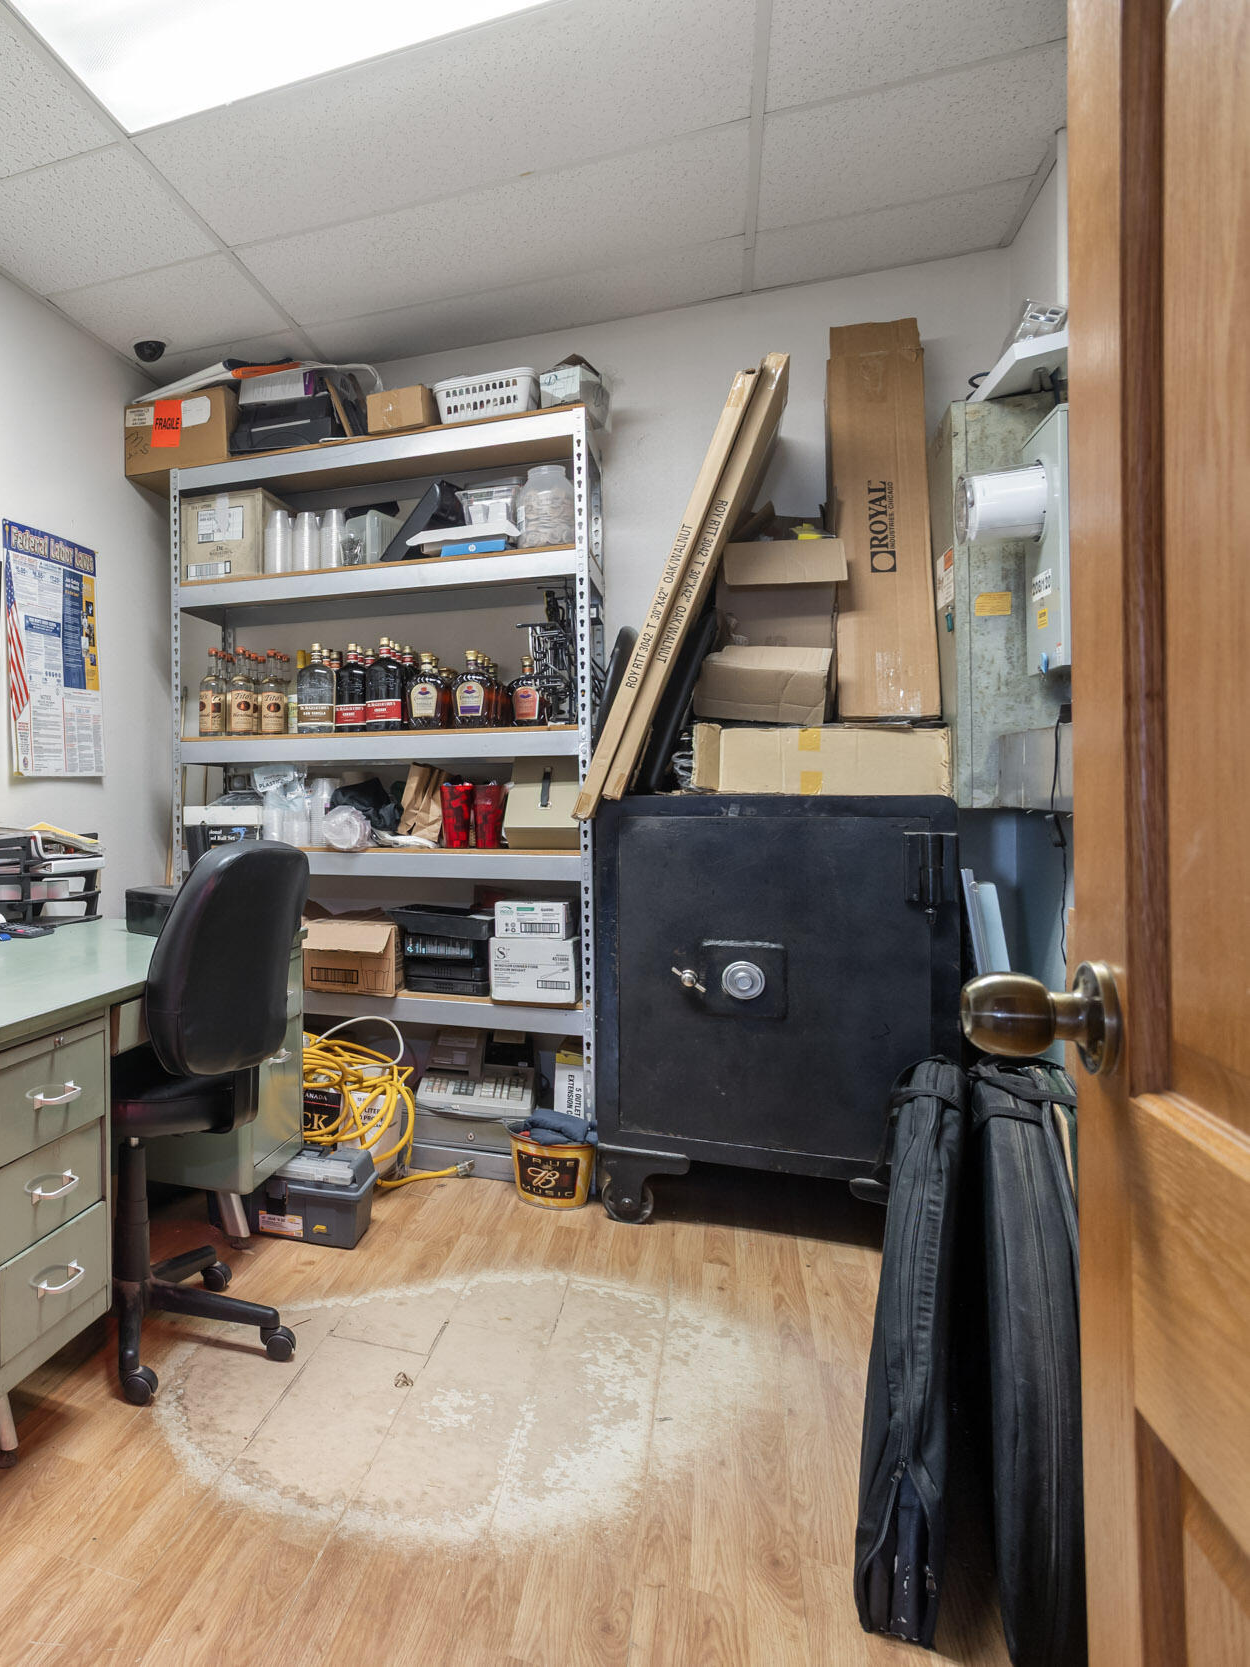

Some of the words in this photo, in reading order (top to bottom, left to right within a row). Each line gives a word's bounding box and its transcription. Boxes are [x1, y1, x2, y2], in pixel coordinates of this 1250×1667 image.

[154, 417, 180, 430] FRAGILE
[887, 481, 895, 509] CHICAGO
[715, 499, 729, 517] ROY
[868, 481, 888, 550] ROYAL
[709, 518, 721, 537] RTT
[11, 525, 49, 558] Federal
[50, 537, 73, 566] Labor
[74, 547, 95, 573] Laws
[663, 523, 694, 584] OAK/WALNUT
[697, 536, 714, 557] 3042
[646, 623, 658, 631] T
[655, 604, 687, 664] OAK/WALNUT
[638, 632, 654, 653] 3042
[632, 652, 646, 671] RTT
[625, 670, 640, 690] ROY
[496, 946, 506, 960] S
[304, 1091, 328, 1102] ANADA
[567, 1074, 575, 1109] EXTENSION
[574, 1093, 582, 1117] OUTLET
[303, 1111, 330, 1130] CK
[519, 1153, 576, 1168] TRUE
[521, 1183, 574, 1197] MUSIC
